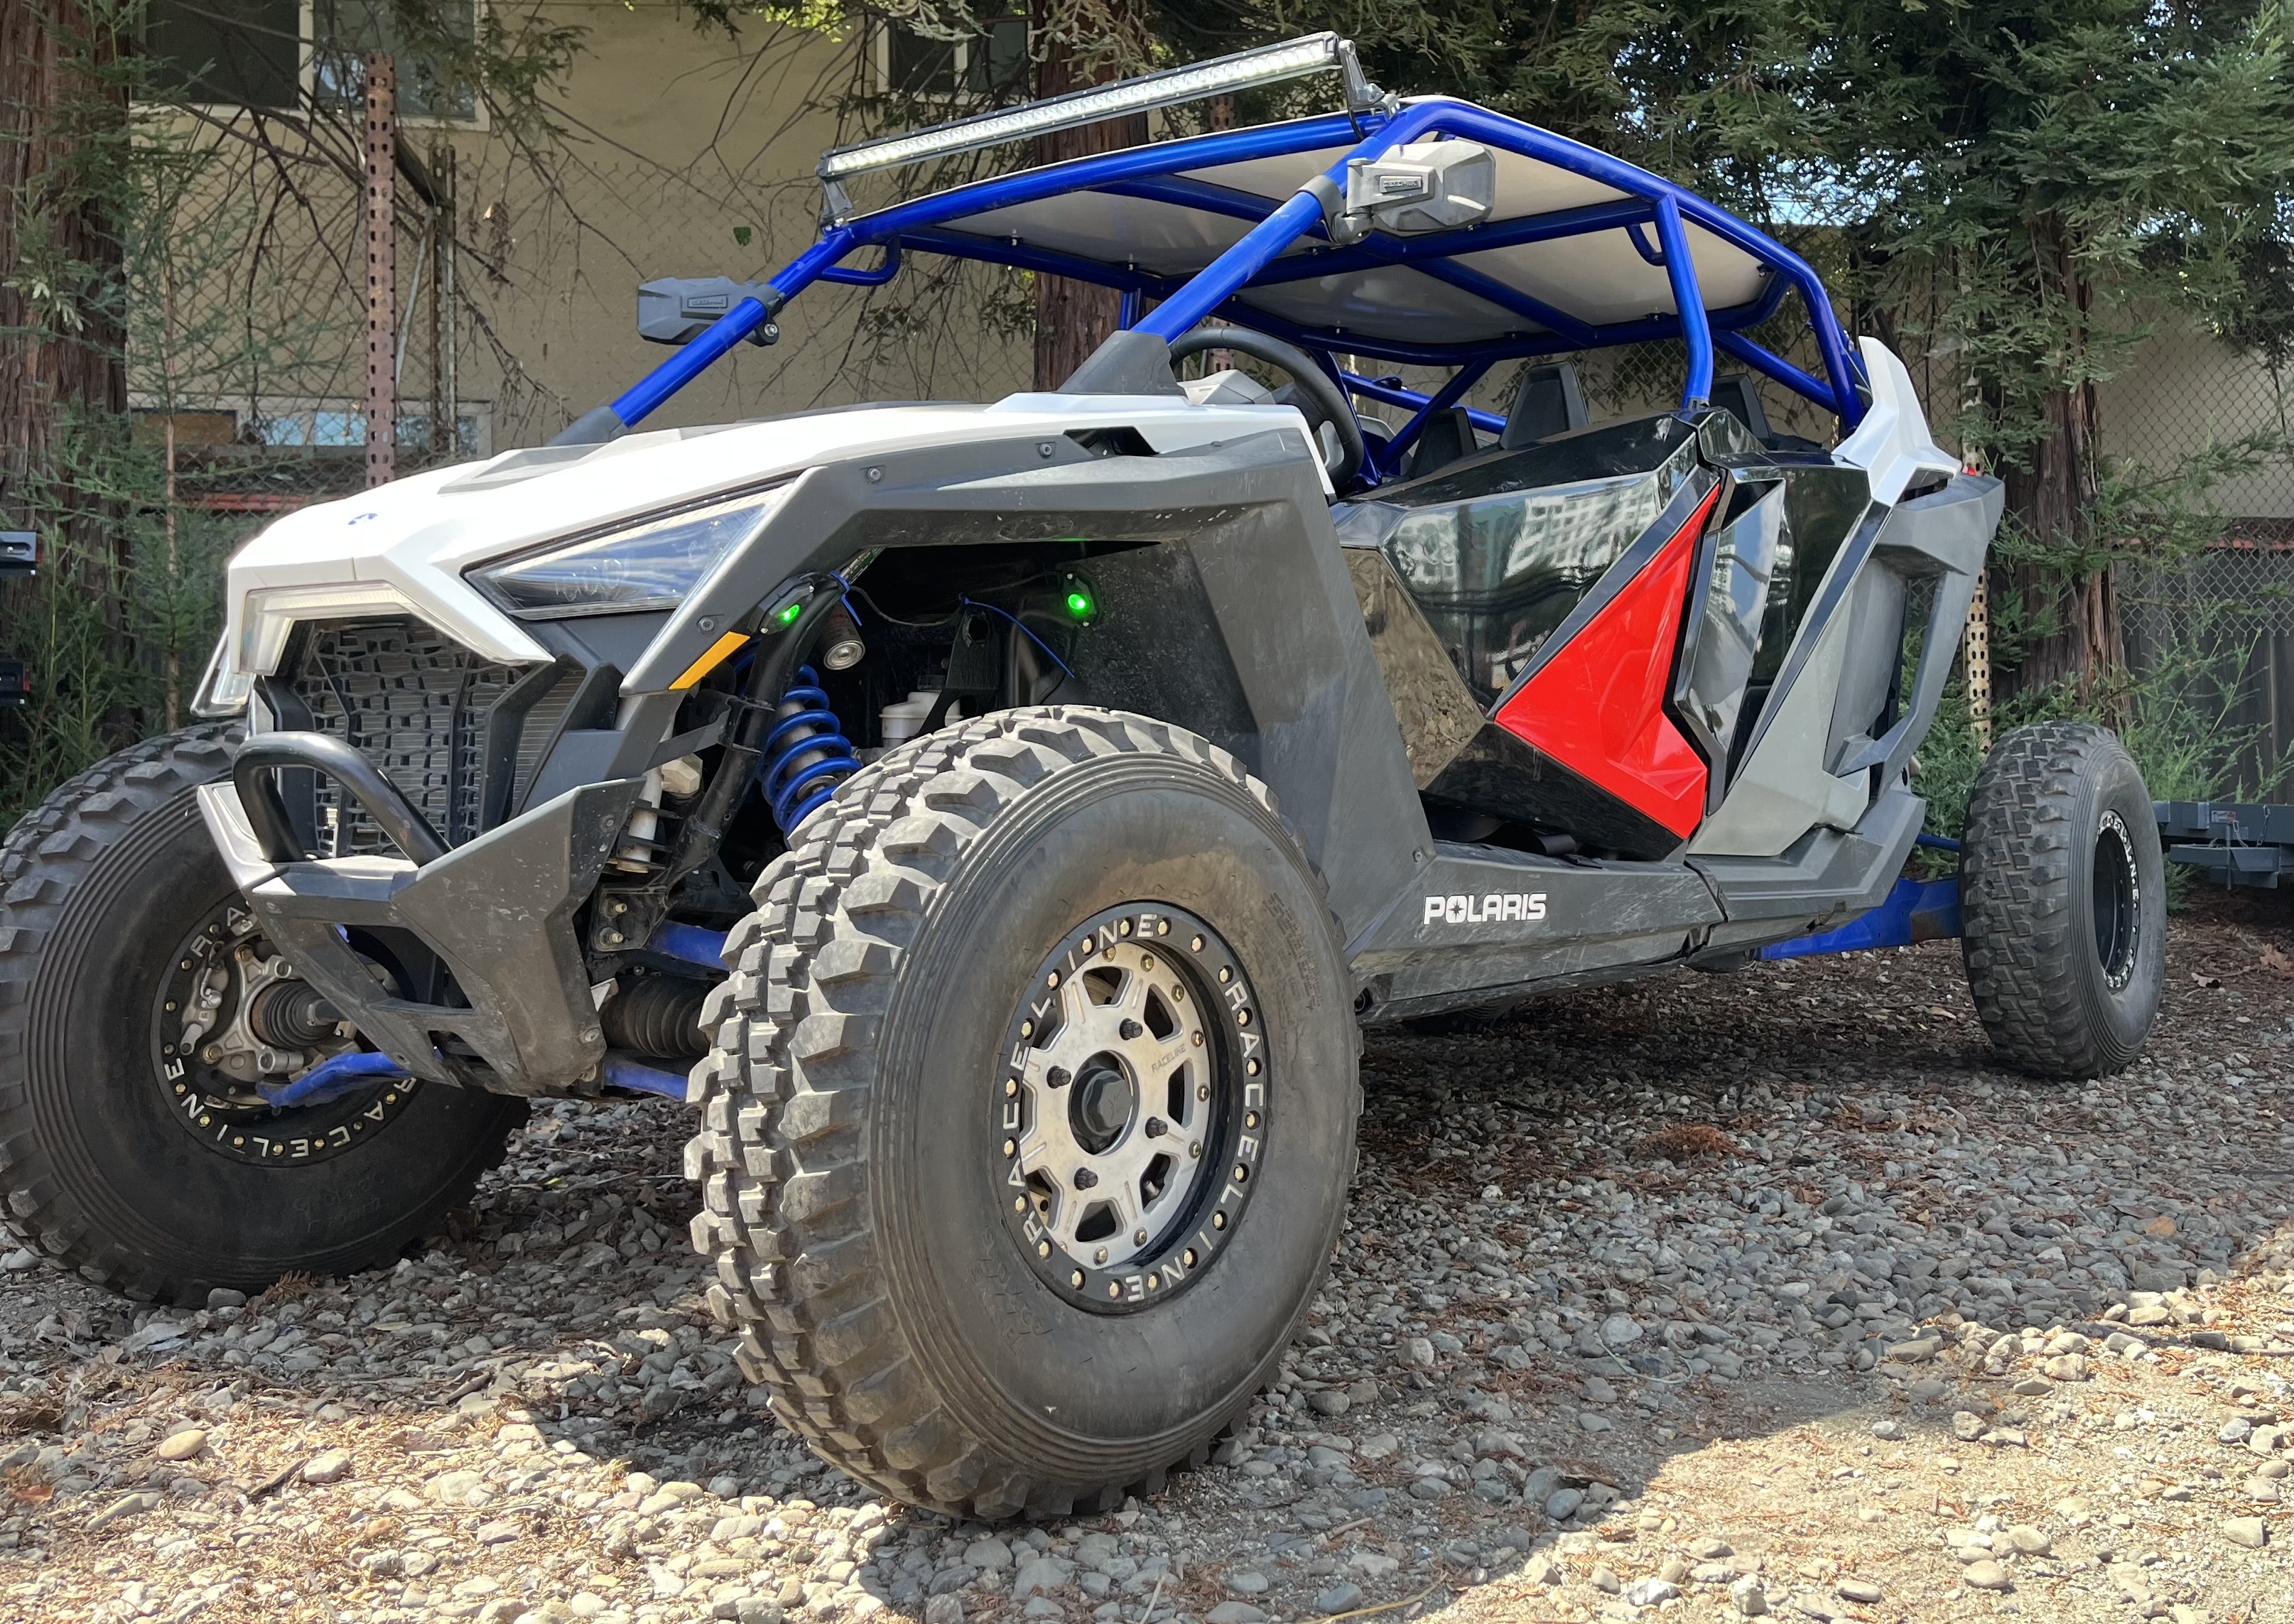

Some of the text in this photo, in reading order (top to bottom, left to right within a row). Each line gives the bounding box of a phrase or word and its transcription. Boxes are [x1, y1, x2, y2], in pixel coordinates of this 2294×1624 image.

[1424, 893, 1547, 925] POLARIS
[164, 1058, 416, 1158] RACELINE
[1002, 914, 1158, 1246] RACELINE
[1151, 1043, 1186, 1074] RACELINE
[1127, 981, 1265, 1303] RACELINE
